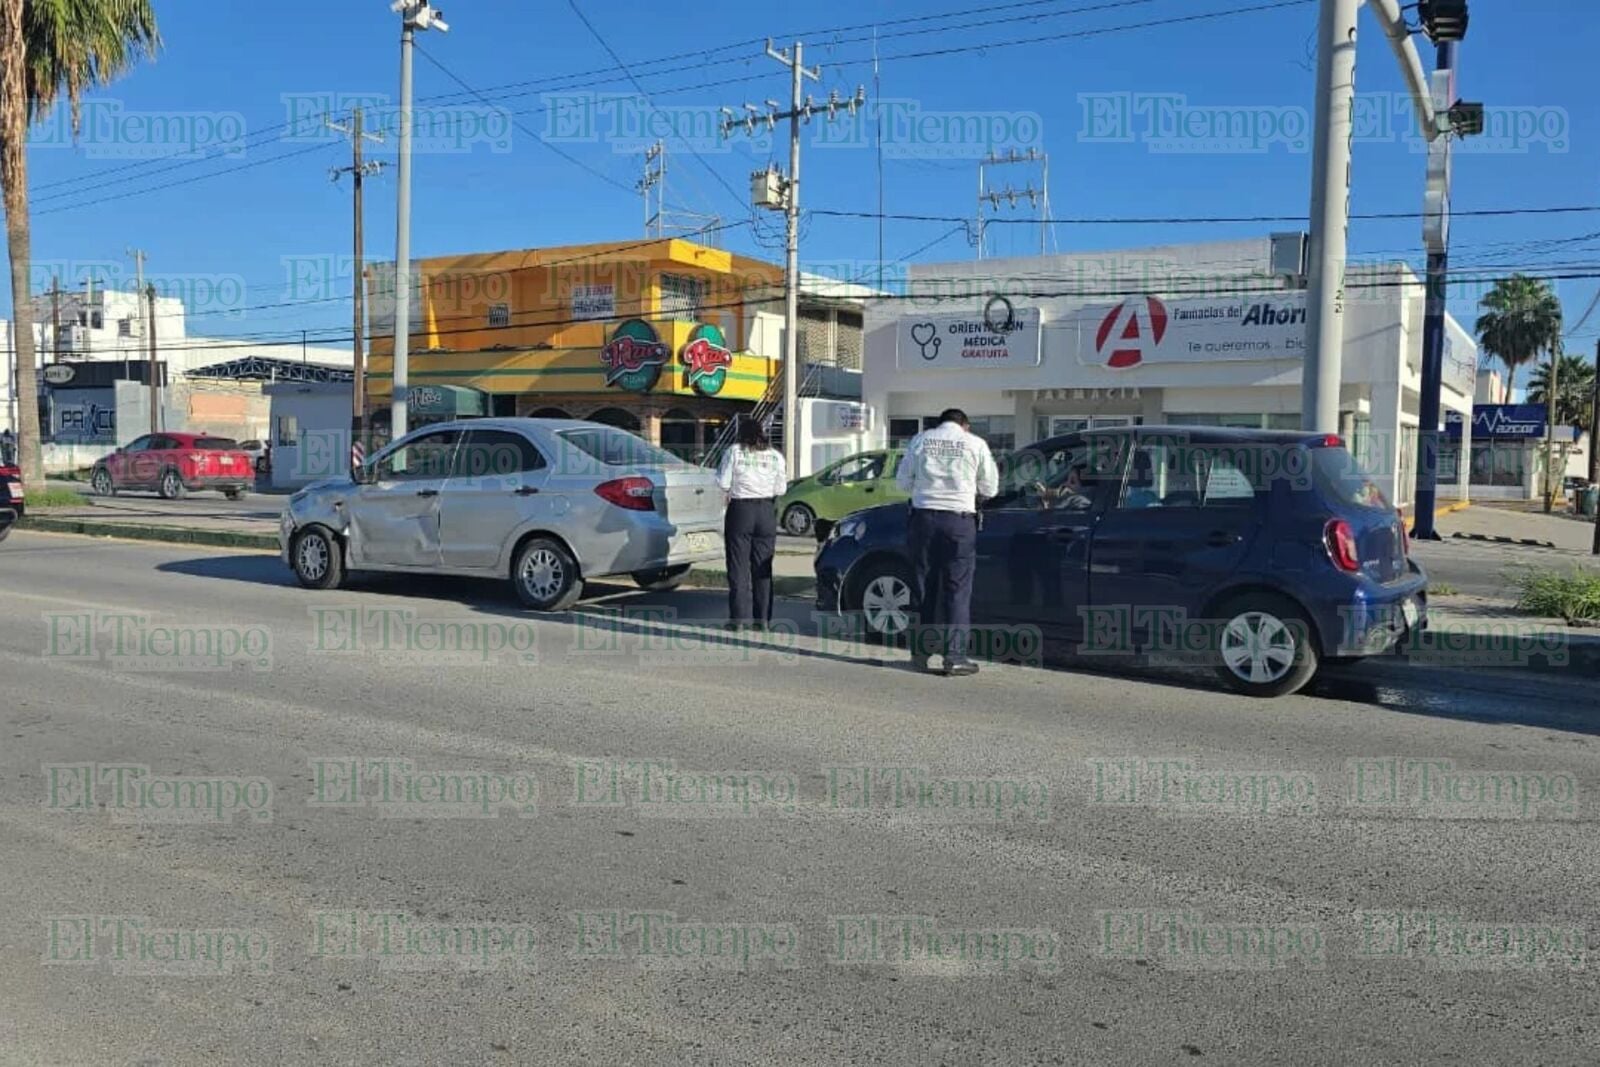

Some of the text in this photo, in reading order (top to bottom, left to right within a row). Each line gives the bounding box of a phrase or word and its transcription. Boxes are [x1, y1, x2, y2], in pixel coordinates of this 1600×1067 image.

[1174, 306, 1224, 320] Farmacias
[1227, 306, 1242, 318] del
[963, 334, 1006, 347] MÉDICA
[961, 348, 1009, 358] GRATUITA
